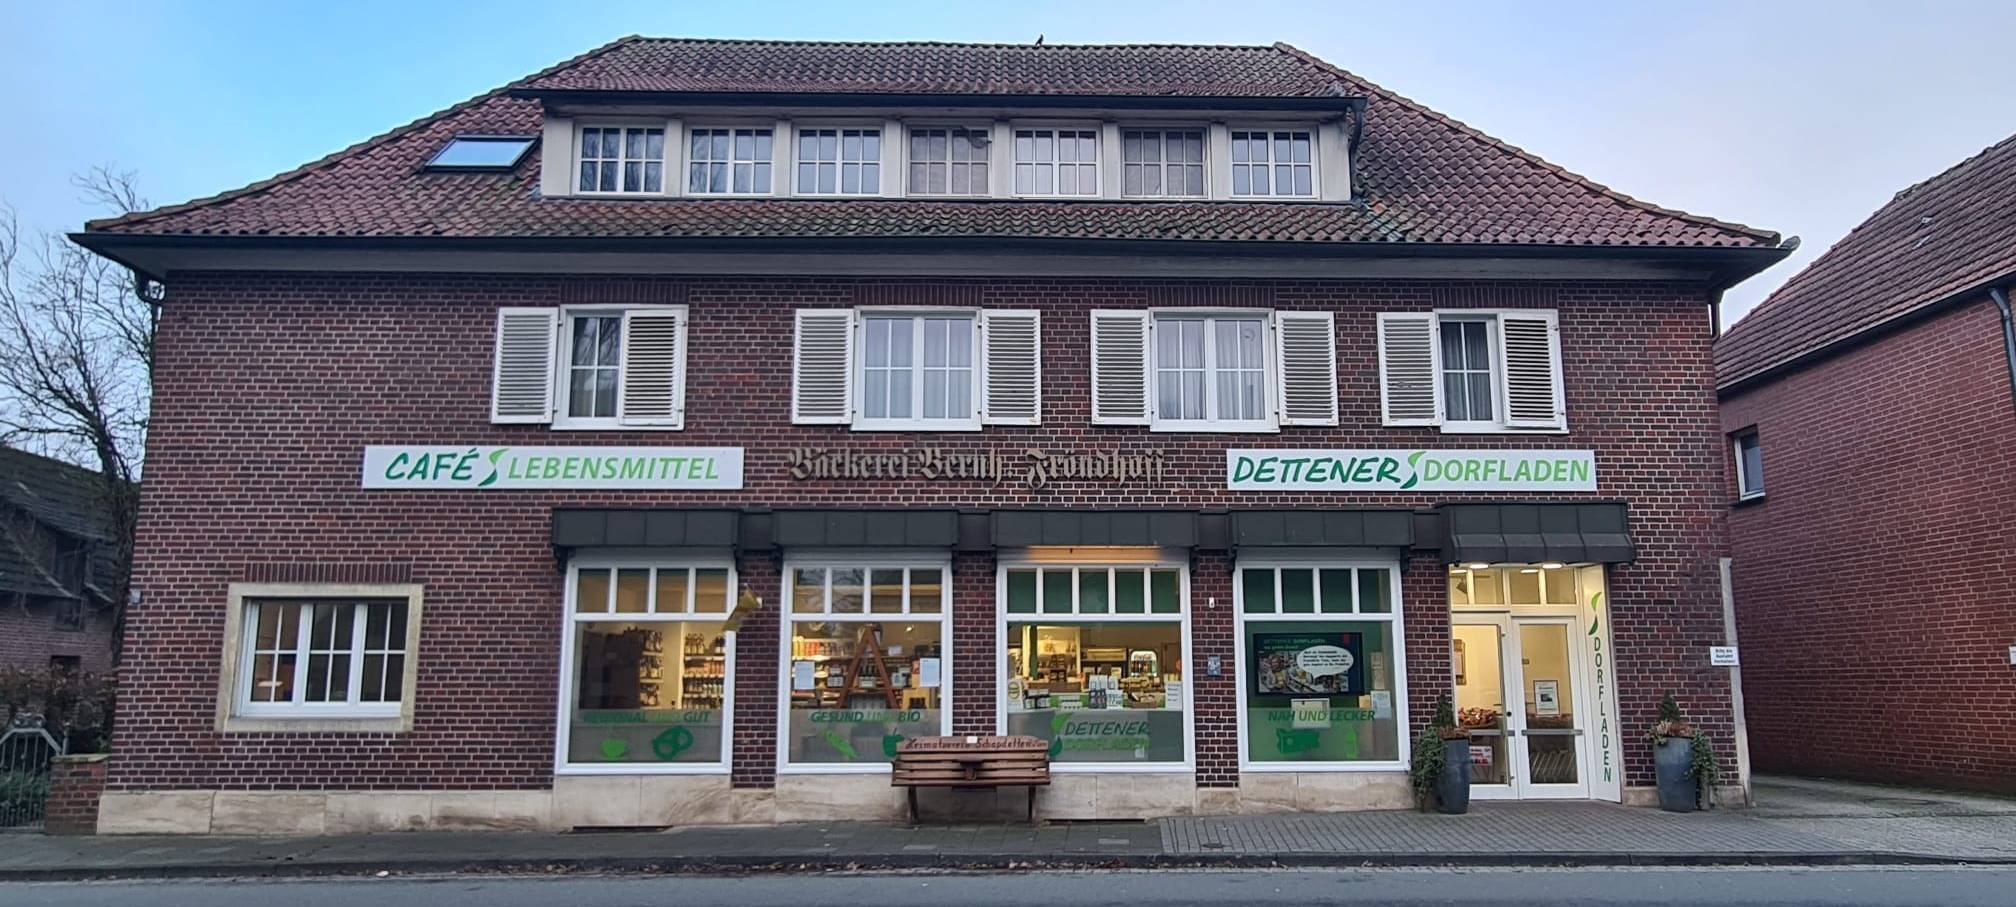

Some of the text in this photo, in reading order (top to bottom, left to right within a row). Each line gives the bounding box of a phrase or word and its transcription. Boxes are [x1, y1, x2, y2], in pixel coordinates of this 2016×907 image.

[385, 447, 719, 480] CAFÉ LEBENSMITTEL
[789, 447, 909, 480] Bäckerei
[1026, 448, 1165, 489] Fröndhoff
[1233, 456, 1590, 484] DETTENER DORFLADEN
[684, 711, 712, 722] GUT
[810, 711, 864, 722] GESUND
[898, 711, 921, 722] BIO
[1268, 710, 1376, 721] NAH UND LECKER
[1594, 636, 1612, 783] DORFLADEN
[1064, 721, 1150, 736] DETTENER
